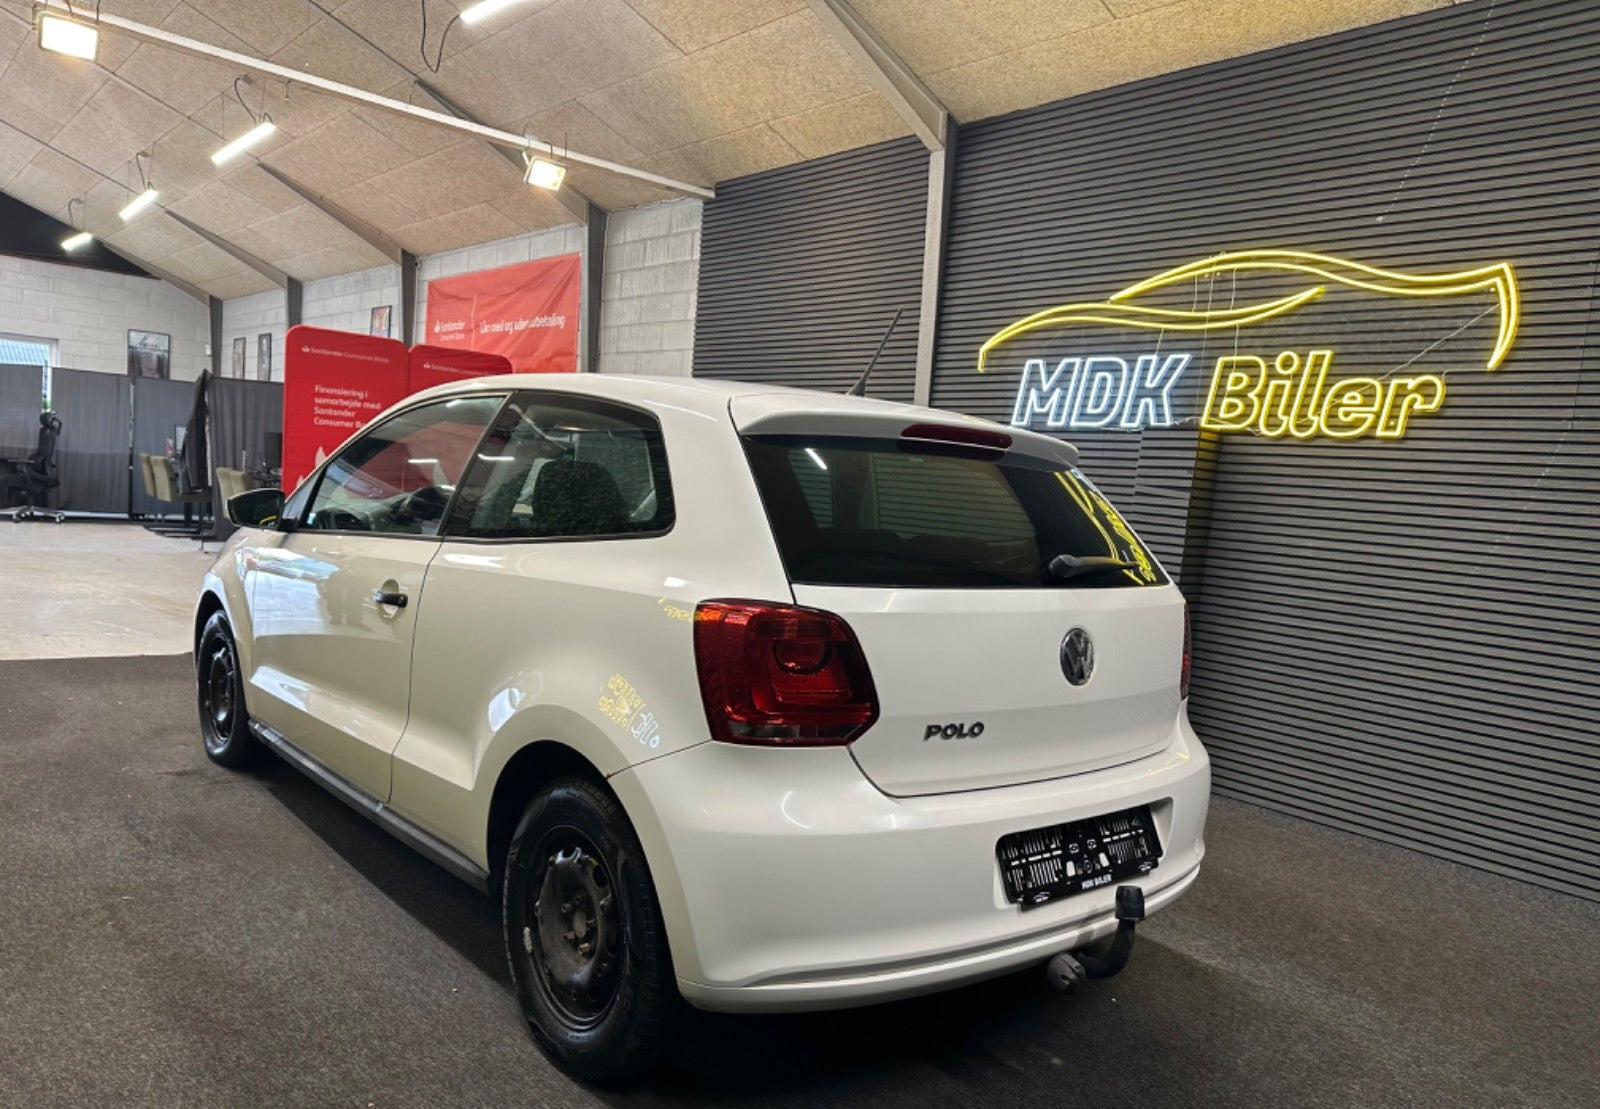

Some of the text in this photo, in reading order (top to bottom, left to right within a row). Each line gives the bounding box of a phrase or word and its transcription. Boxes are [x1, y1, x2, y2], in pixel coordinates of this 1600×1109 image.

[310, 346, 343, 357] Santander
[344, 351, 374, 361] Consumer
[314, 384, 364, 399] Finansiering
[1010, 349, 1447, 438] MDK Biler
[314, 397, 382, 410] samarbejde med
[313, 406, 356, 417] Santander
[313, 416, 354, 428] Consumer
[923, 721, 985, 742] POLO
